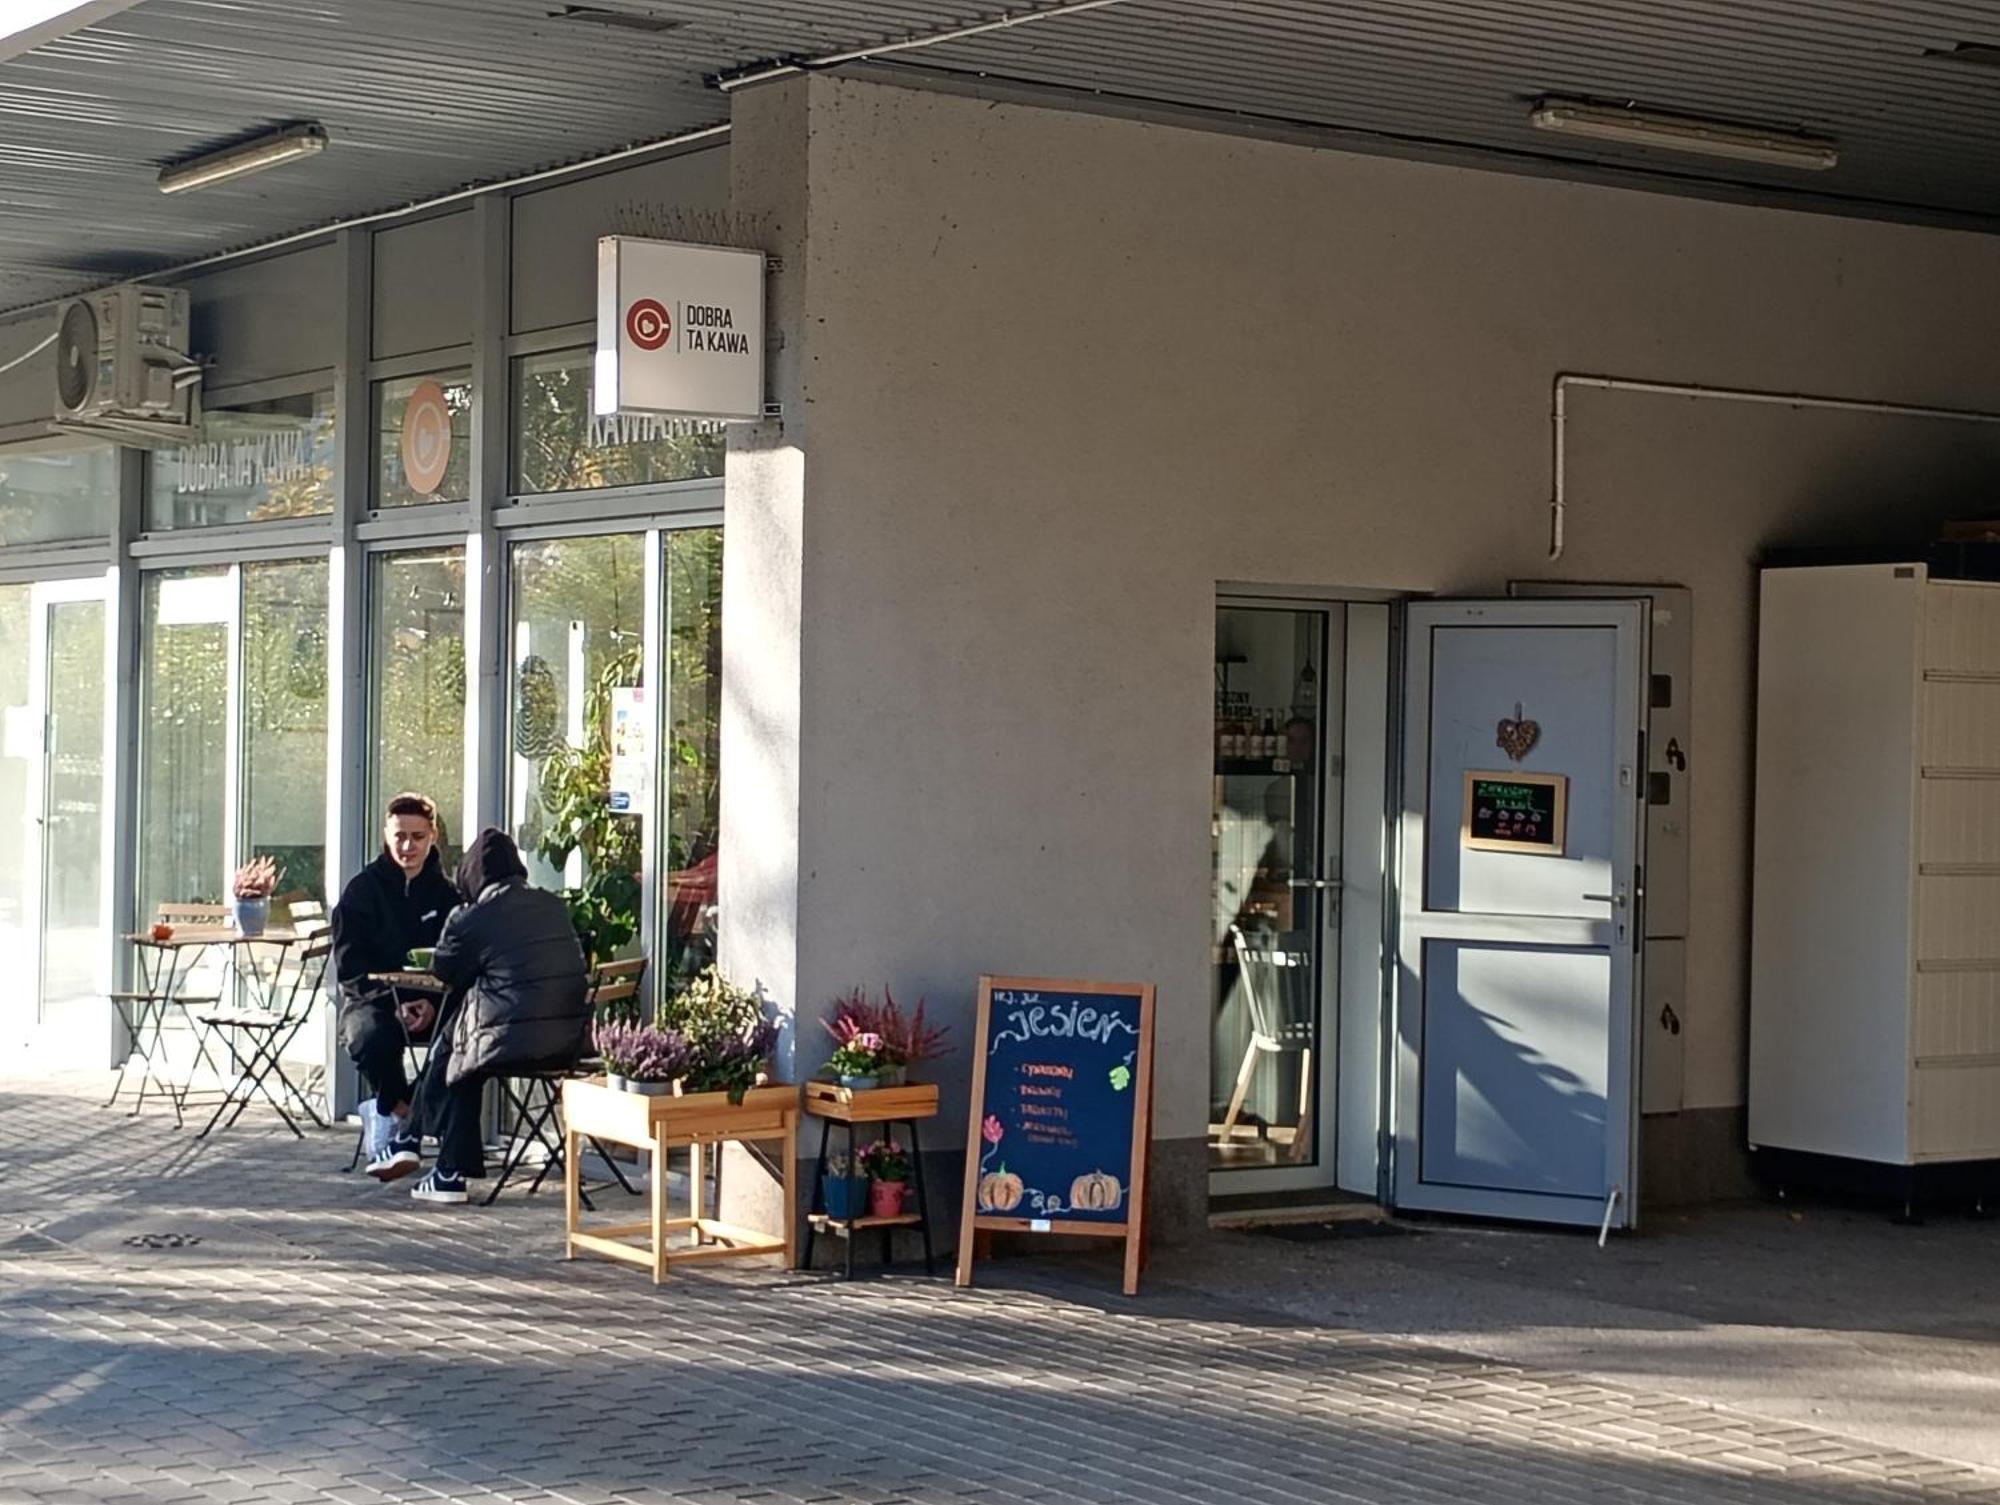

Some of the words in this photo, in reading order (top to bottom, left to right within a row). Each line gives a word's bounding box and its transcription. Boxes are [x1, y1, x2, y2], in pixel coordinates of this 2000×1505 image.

[686, 304, 733, 329] DOBRA
[686, 329, 704, 351] TA
[707, 333, 750, 355] KAWA
[178, 440, 229, 493] DOBRA
